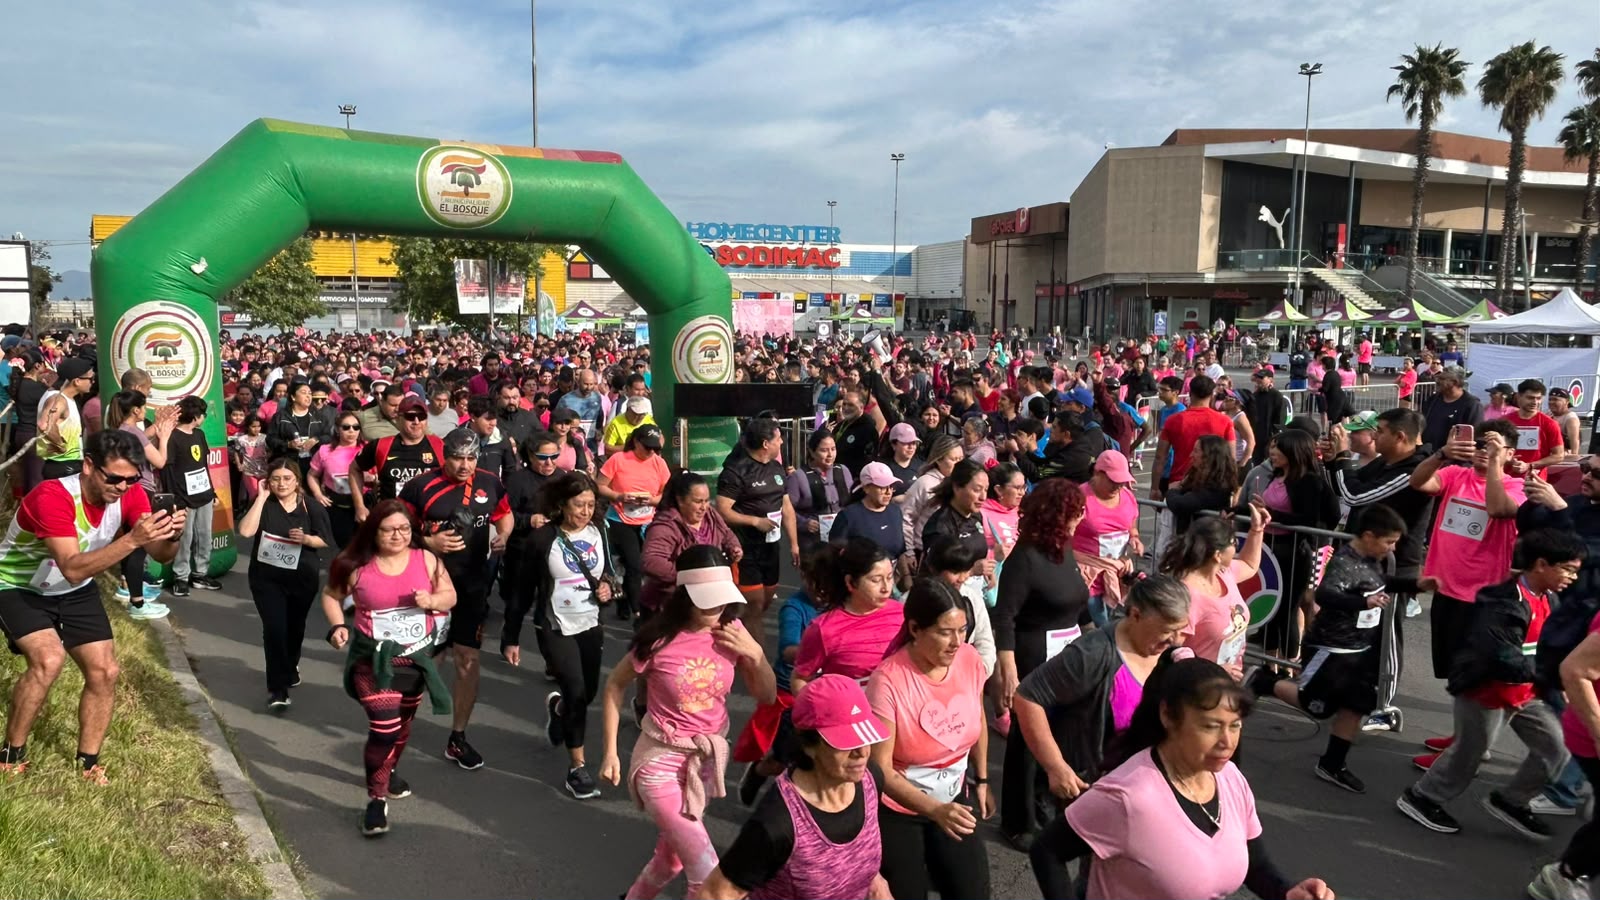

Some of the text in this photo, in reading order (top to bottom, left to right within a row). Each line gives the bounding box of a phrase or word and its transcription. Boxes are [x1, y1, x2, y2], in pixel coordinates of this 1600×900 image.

[440, 203, 489, 215] EL BOSQUE
[687, 222, 842, 243] HOMECENTER
[717, 245, 841, 268] SODIMAC
[156, 369, 187, 378] BOSQUE
[207, 449, 222, 465] DO
[1457, 507, 1472, 517] 159
[566, 551, 597, 563] NSA
